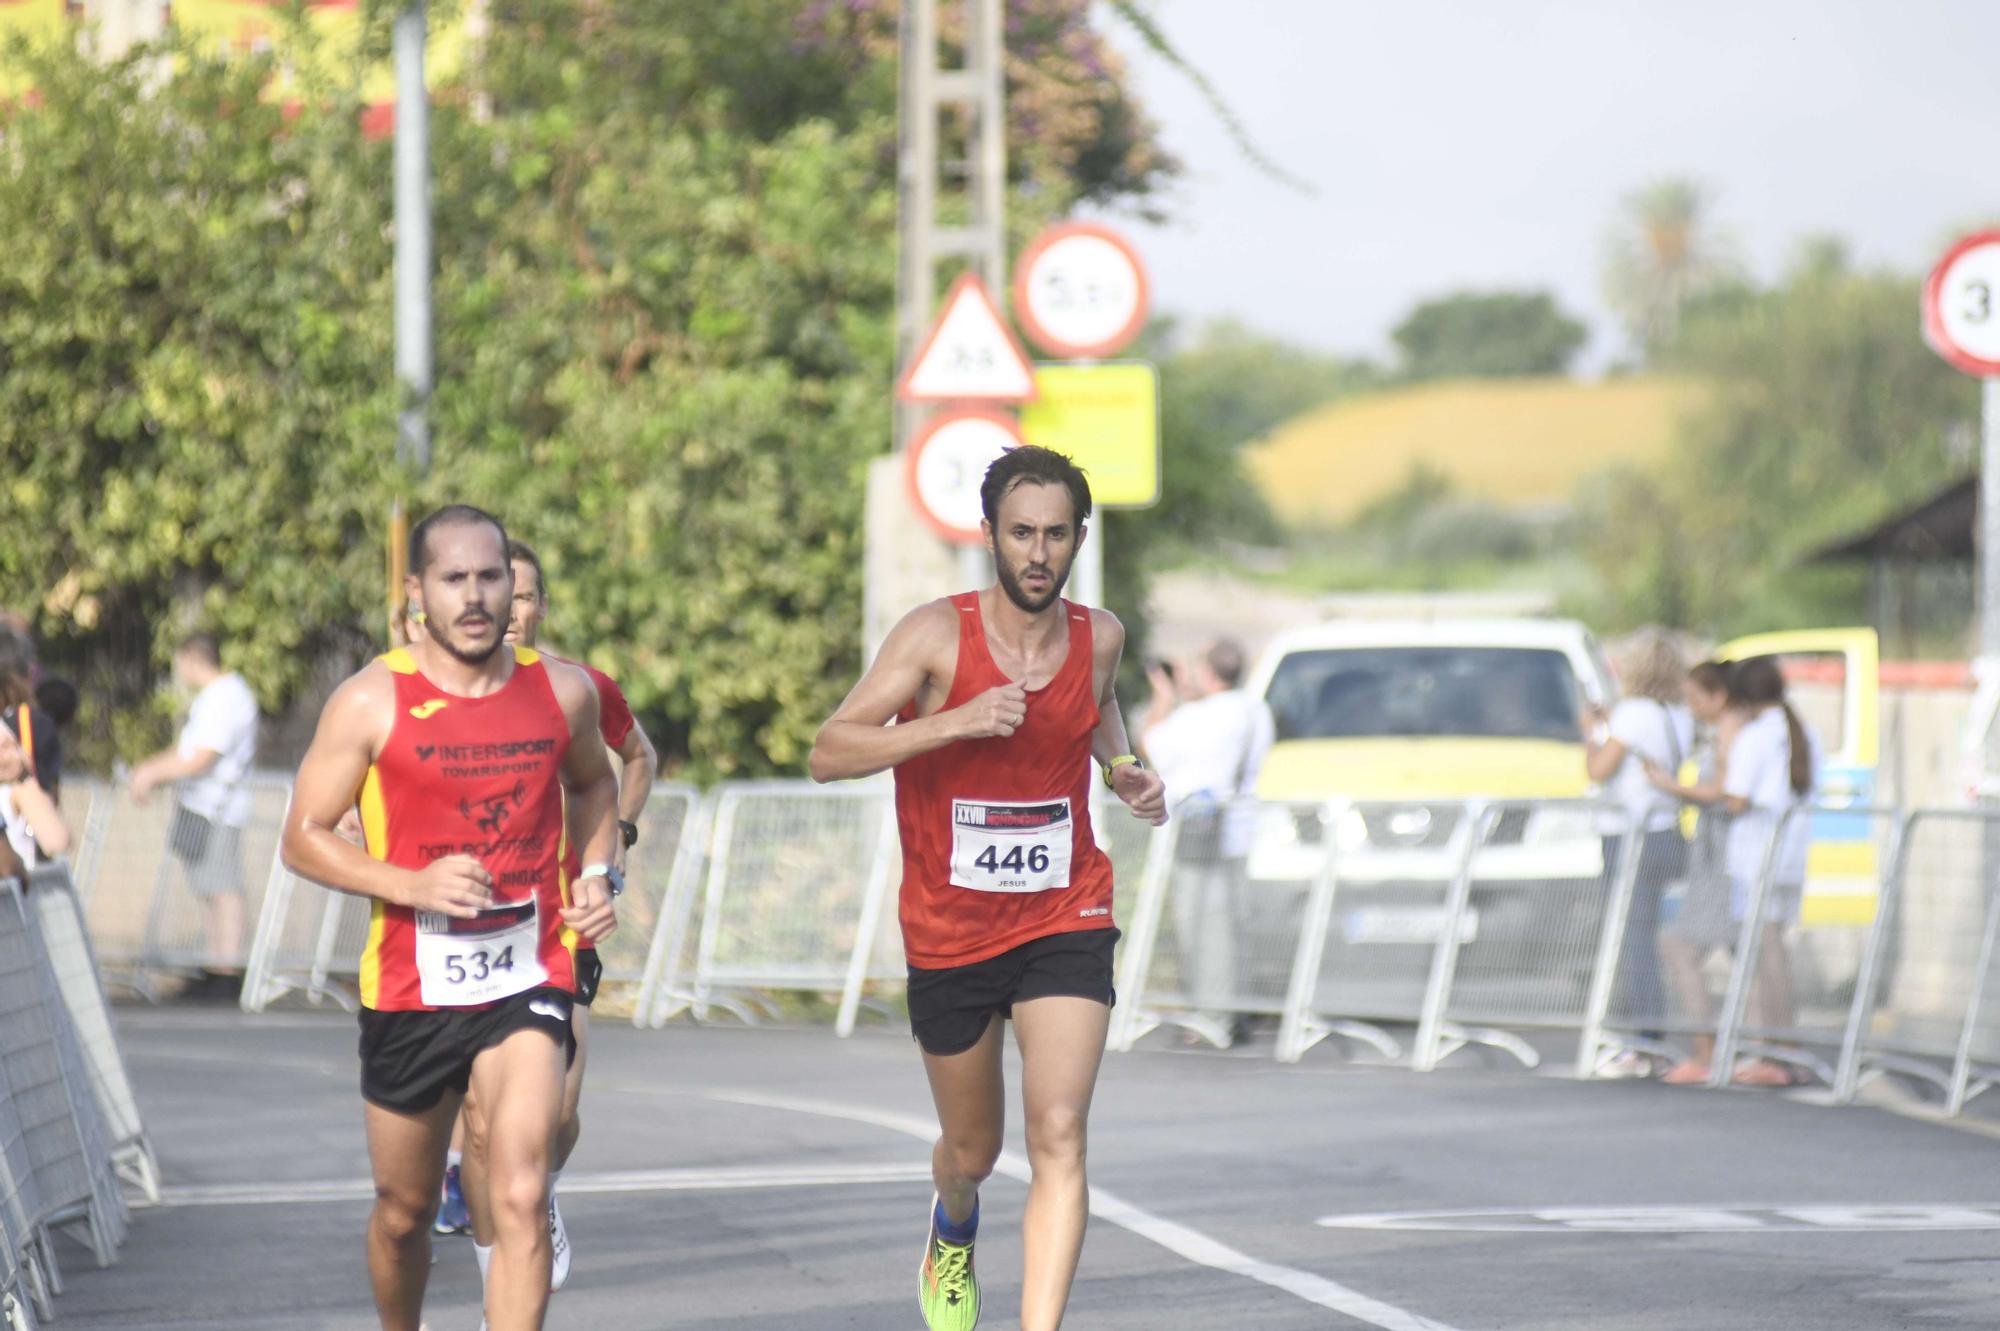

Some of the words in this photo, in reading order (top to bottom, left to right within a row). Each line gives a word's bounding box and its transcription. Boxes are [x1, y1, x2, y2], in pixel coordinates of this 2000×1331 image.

[440, 738, 555, 761] INTERSPORT
[441, 761, 542, 778] TOVARSPORT
[956, 804, 986, 826] XXVIII
[974, 844, 1050, 875] 446
[998, 880, 1027, 888] JESUS
[444, 944, 514, 985] 534
